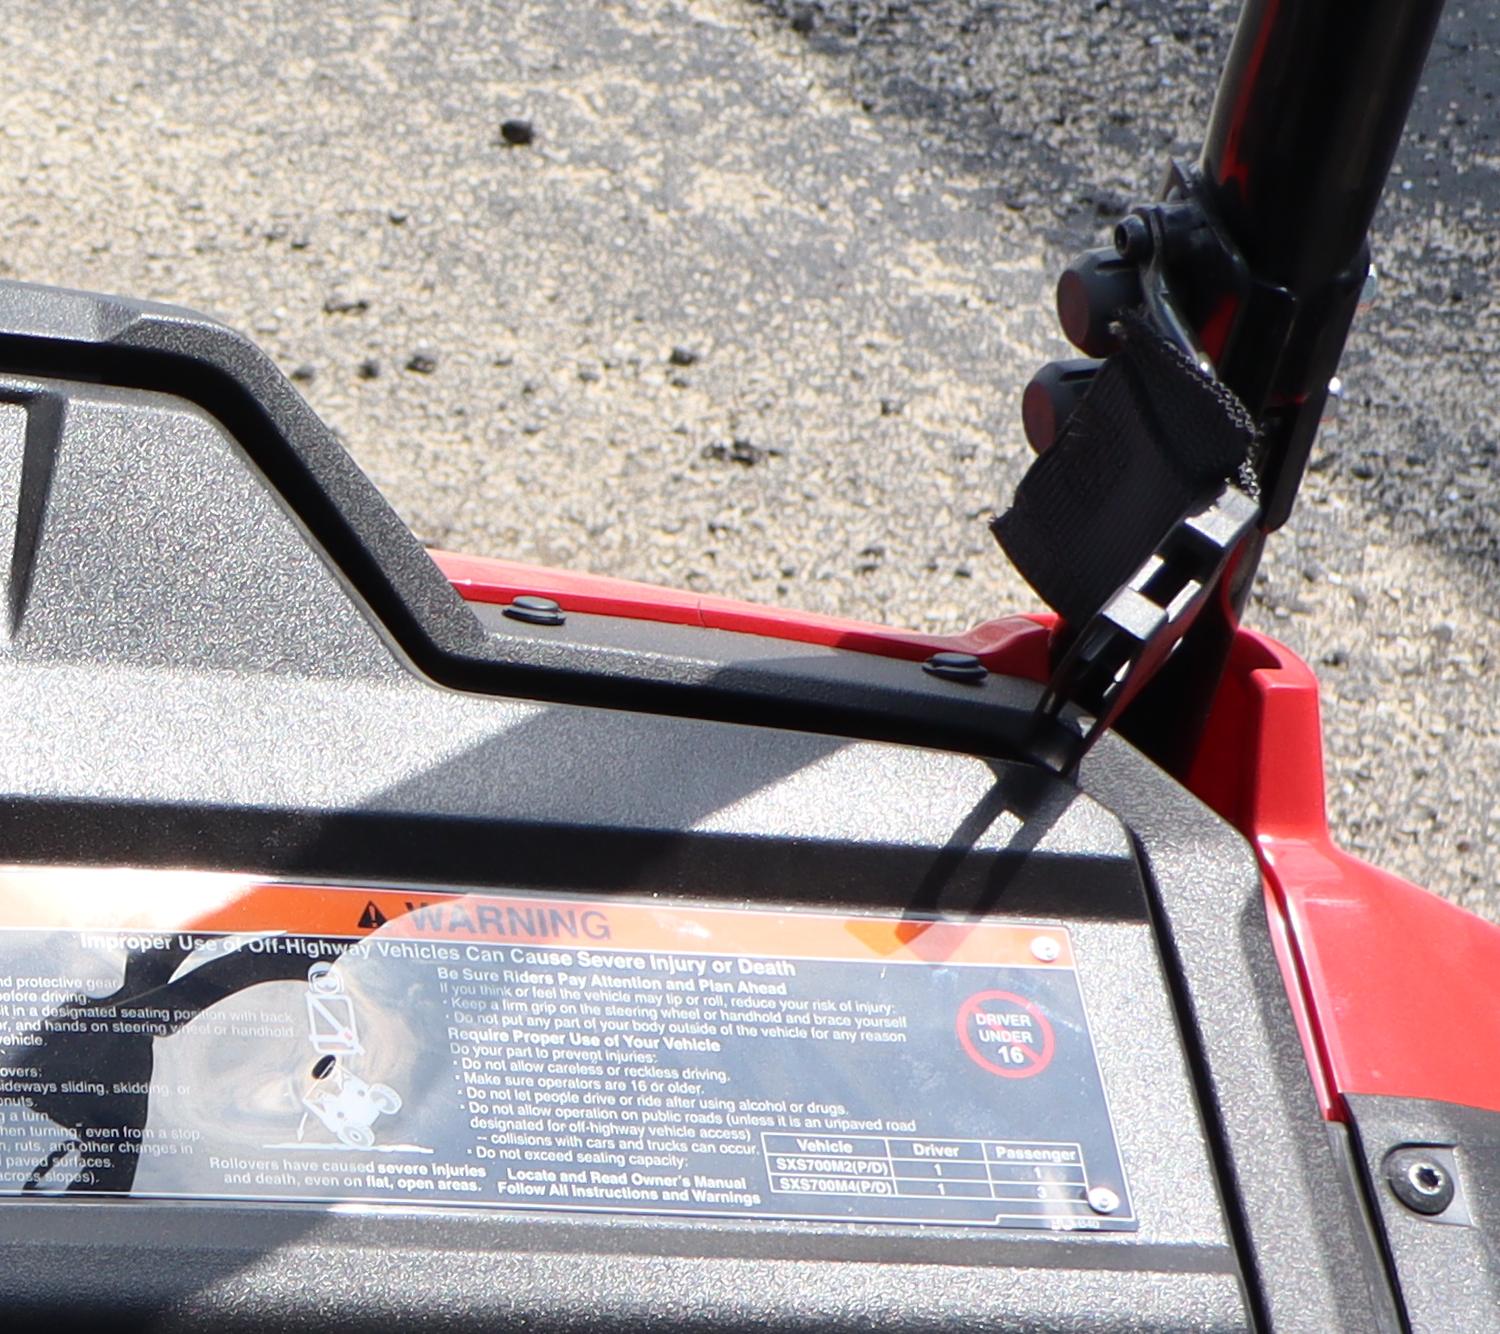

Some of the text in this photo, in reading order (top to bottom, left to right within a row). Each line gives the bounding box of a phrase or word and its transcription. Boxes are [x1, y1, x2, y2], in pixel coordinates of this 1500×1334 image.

[404, 901, 612, 939] WARNING
[80, 932, 173, 955] Improper
[178, 935, 216, 953] Use
[248, 938, 373, 962] Off-Highway
[377, 942, 460, 962] Vehicles
[465, 946, 506, 964] Can
[510, 948, 574, 967] Cause
[576, 951, 646, 970] Severe
[649, 954, 708, 977] Injury
[711, 960, 736, 974] or
[739, 958, 797, 977] Death
[438, 966, 788, 995] Be Sure Riders Pay Attention and Plan Ahead
[975, 1013, 1032, 1028] DRIVER
[447, 1027, 722, 1052] Require Proper Use of Your Vehicle
[978, 1031, 1034, 1045] UNDER
[997, 1045, 1024, 1064] 16
[461, 1057, 482, 1070] Do
[484, 1059, 507, 1071] not
[510, 1059, 544, 1072] allow
[546, 1062, 604, 1075] careless
[606, 1066, 622, 1076] or
[623, 1065, 680, 1078] reckless
[463, 1072, 501, 1085] Make
[504, 1076, 534, 1087] sure
[537, 1077, 602, 1090] operators
[604, 1080, 626, 1091] are
[630, 1079, 648, 1092] 16
[650, 1082, 664, 1093] or
[796, 1138, 1076, 1164] Vehicle Driver Passenger
[506, 1167, 746, 1190] Locate and Read Owner's Manual
[775, 1156, 1042, 1179] SXS700M2(P/D) 1 1
[497, 1180, 762, 1207] Follow All Instructions and Warnings
[778, 1177, 893, 1196] SXS700M4(P/D)
[937, 1183, 946, 1196] 1
